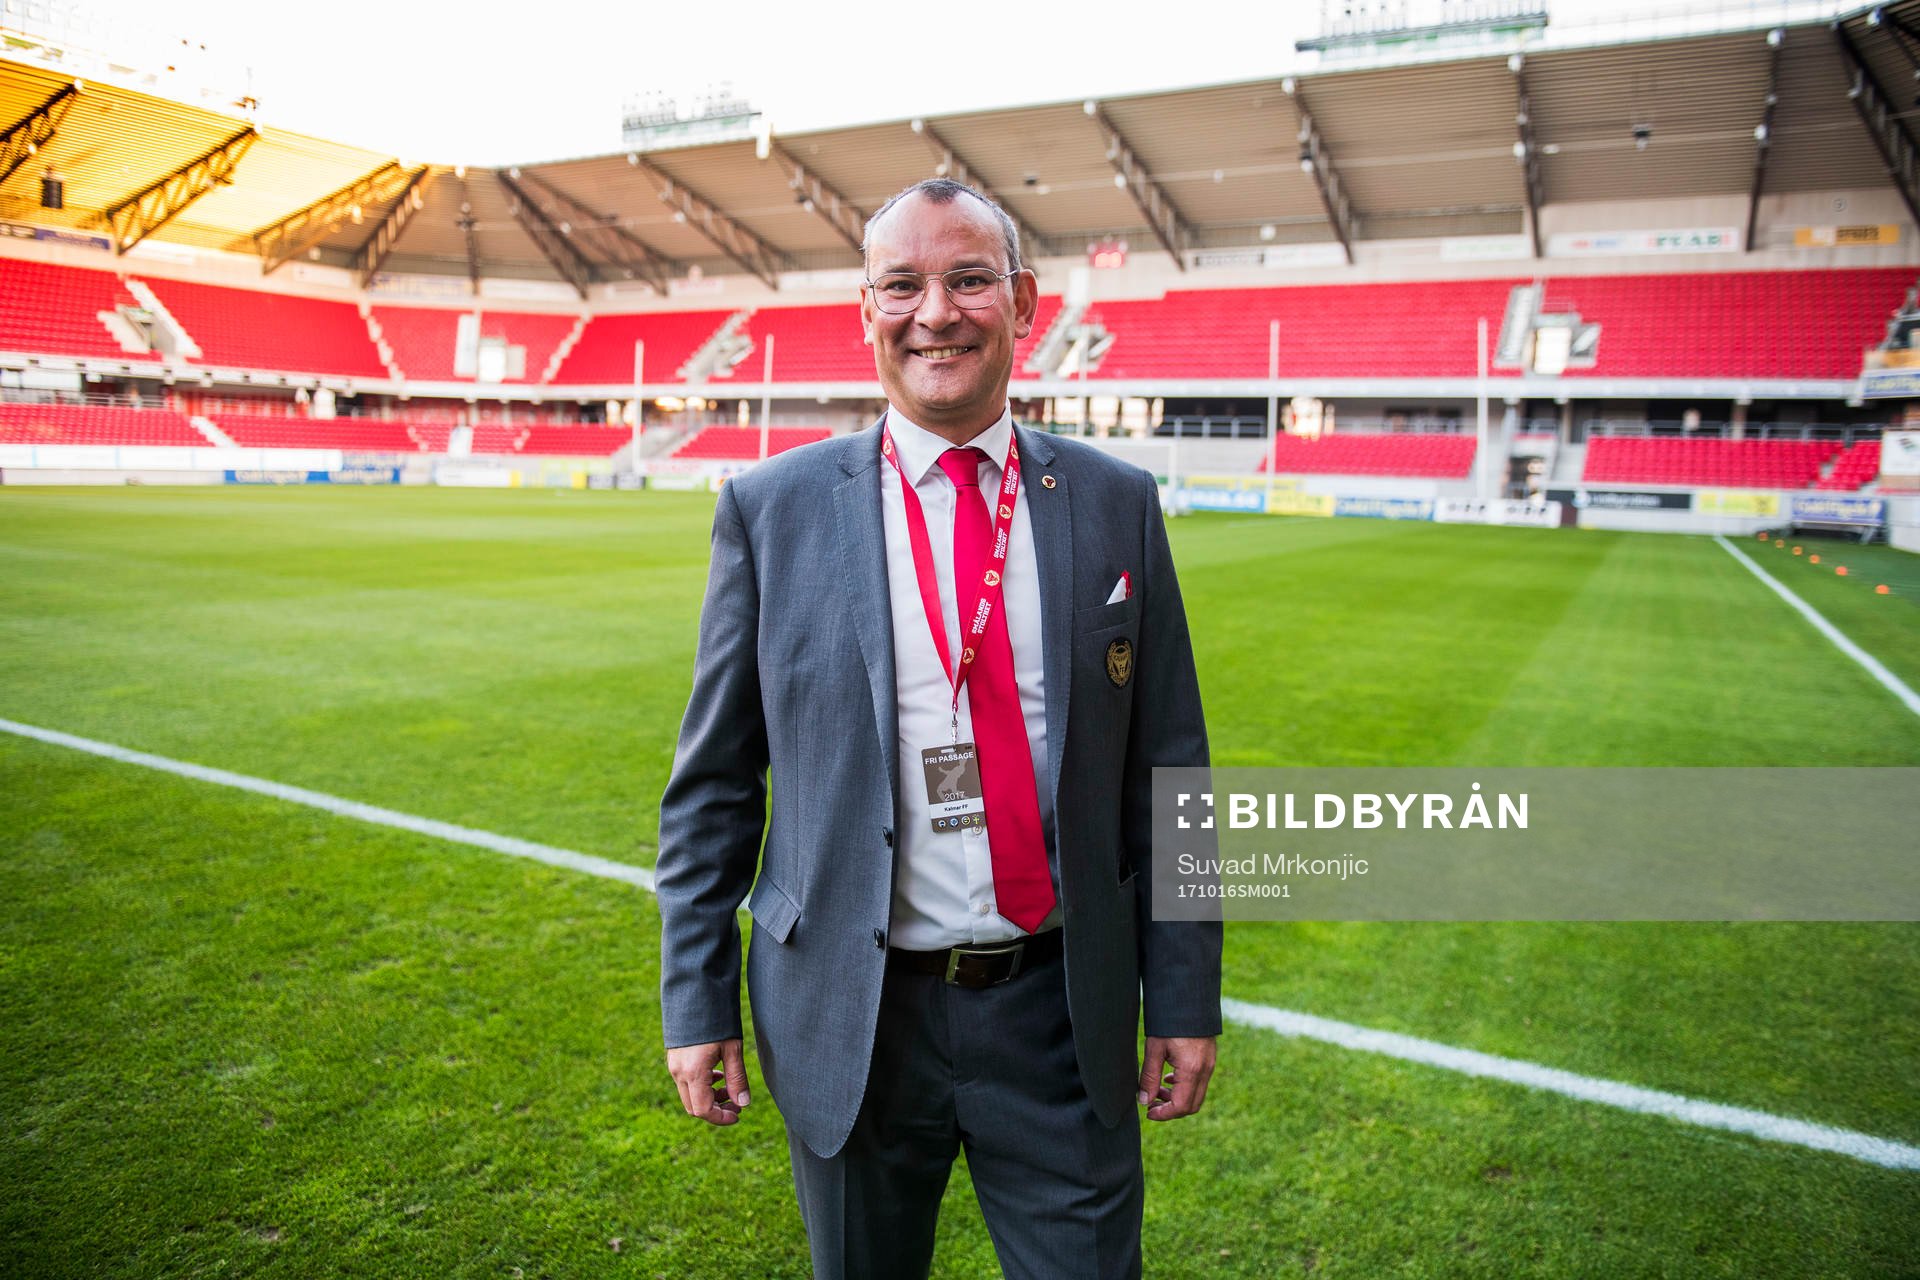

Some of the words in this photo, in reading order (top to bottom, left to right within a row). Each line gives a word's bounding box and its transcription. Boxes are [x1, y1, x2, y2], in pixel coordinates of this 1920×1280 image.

[1004, 465, 1014, 495] SMÅLANDS
[993, 527, 1004, 559] SMÅLANDS
[971, 597, 987, 635] SMÅLANDS
[977, 601, 992, 635] STOLTHET
[925, 757, 938, 765] FRI
[938, 751, 974, 763] PASSAGE
[944, 791, 965, 801] 2017
